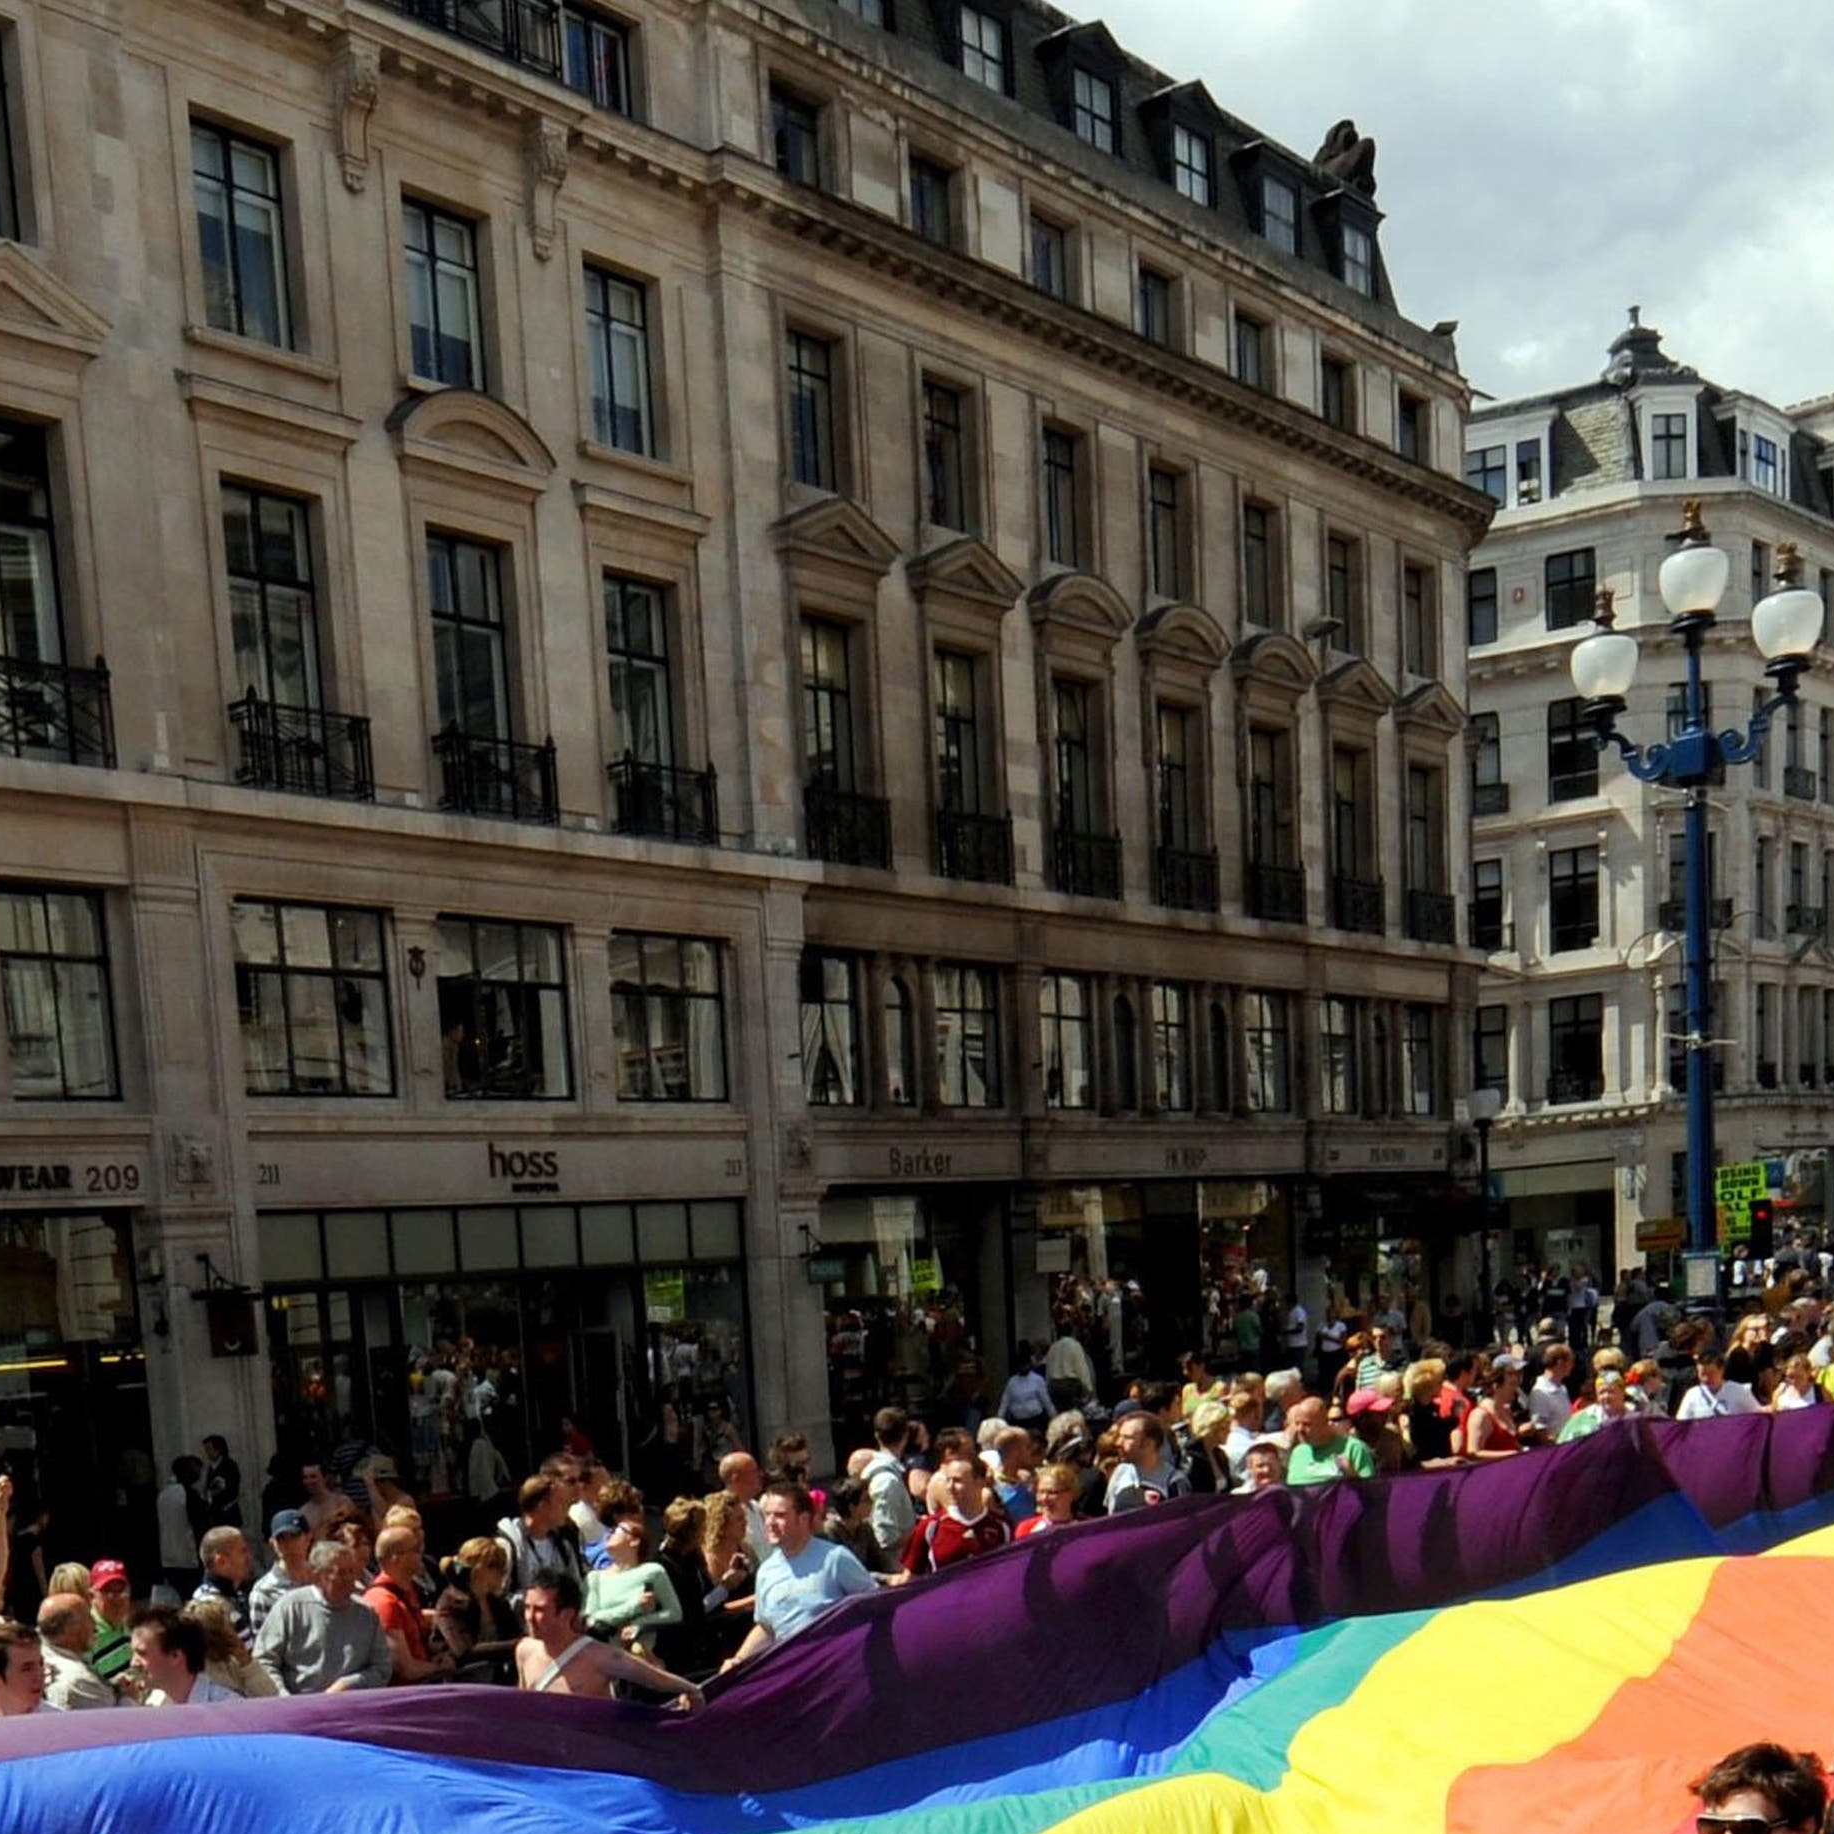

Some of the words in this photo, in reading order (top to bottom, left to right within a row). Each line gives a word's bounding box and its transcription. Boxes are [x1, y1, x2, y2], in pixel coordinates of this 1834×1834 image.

[488, 1142, 558, 1177] hoss
[889, 1144, 952, 1176] Barker
[85, 1165, 141, 1193] 209
[1720, 1188, 1763, 1202] OLF
